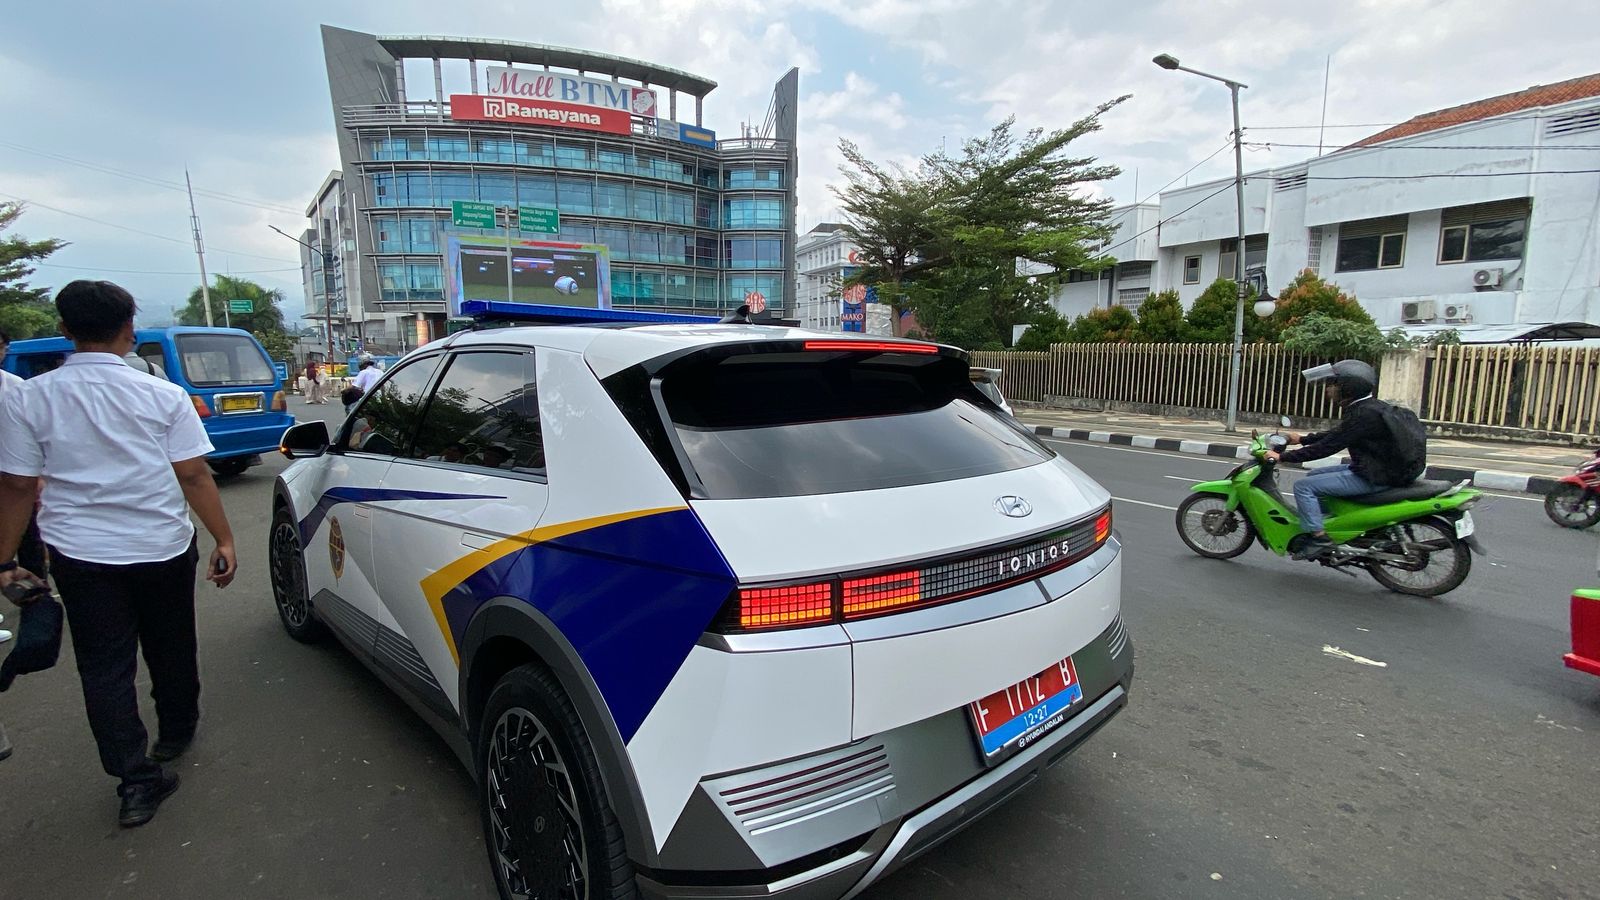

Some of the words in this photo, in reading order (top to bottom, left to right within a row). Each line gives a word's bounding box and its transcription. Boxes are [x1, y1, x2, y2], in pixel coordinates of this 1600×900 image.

[491, 72, 555, 98] Mall
[560, 77, 630, 110] BTM
[507, 102, 601, 126] Ramayana
[976, 701, 989, 732] F
[1059, 657, 1071, 687] B
[1025, 725, 1045, 743] HYUNDAI
[1044, 714, 1064, 731] ANDALAN
